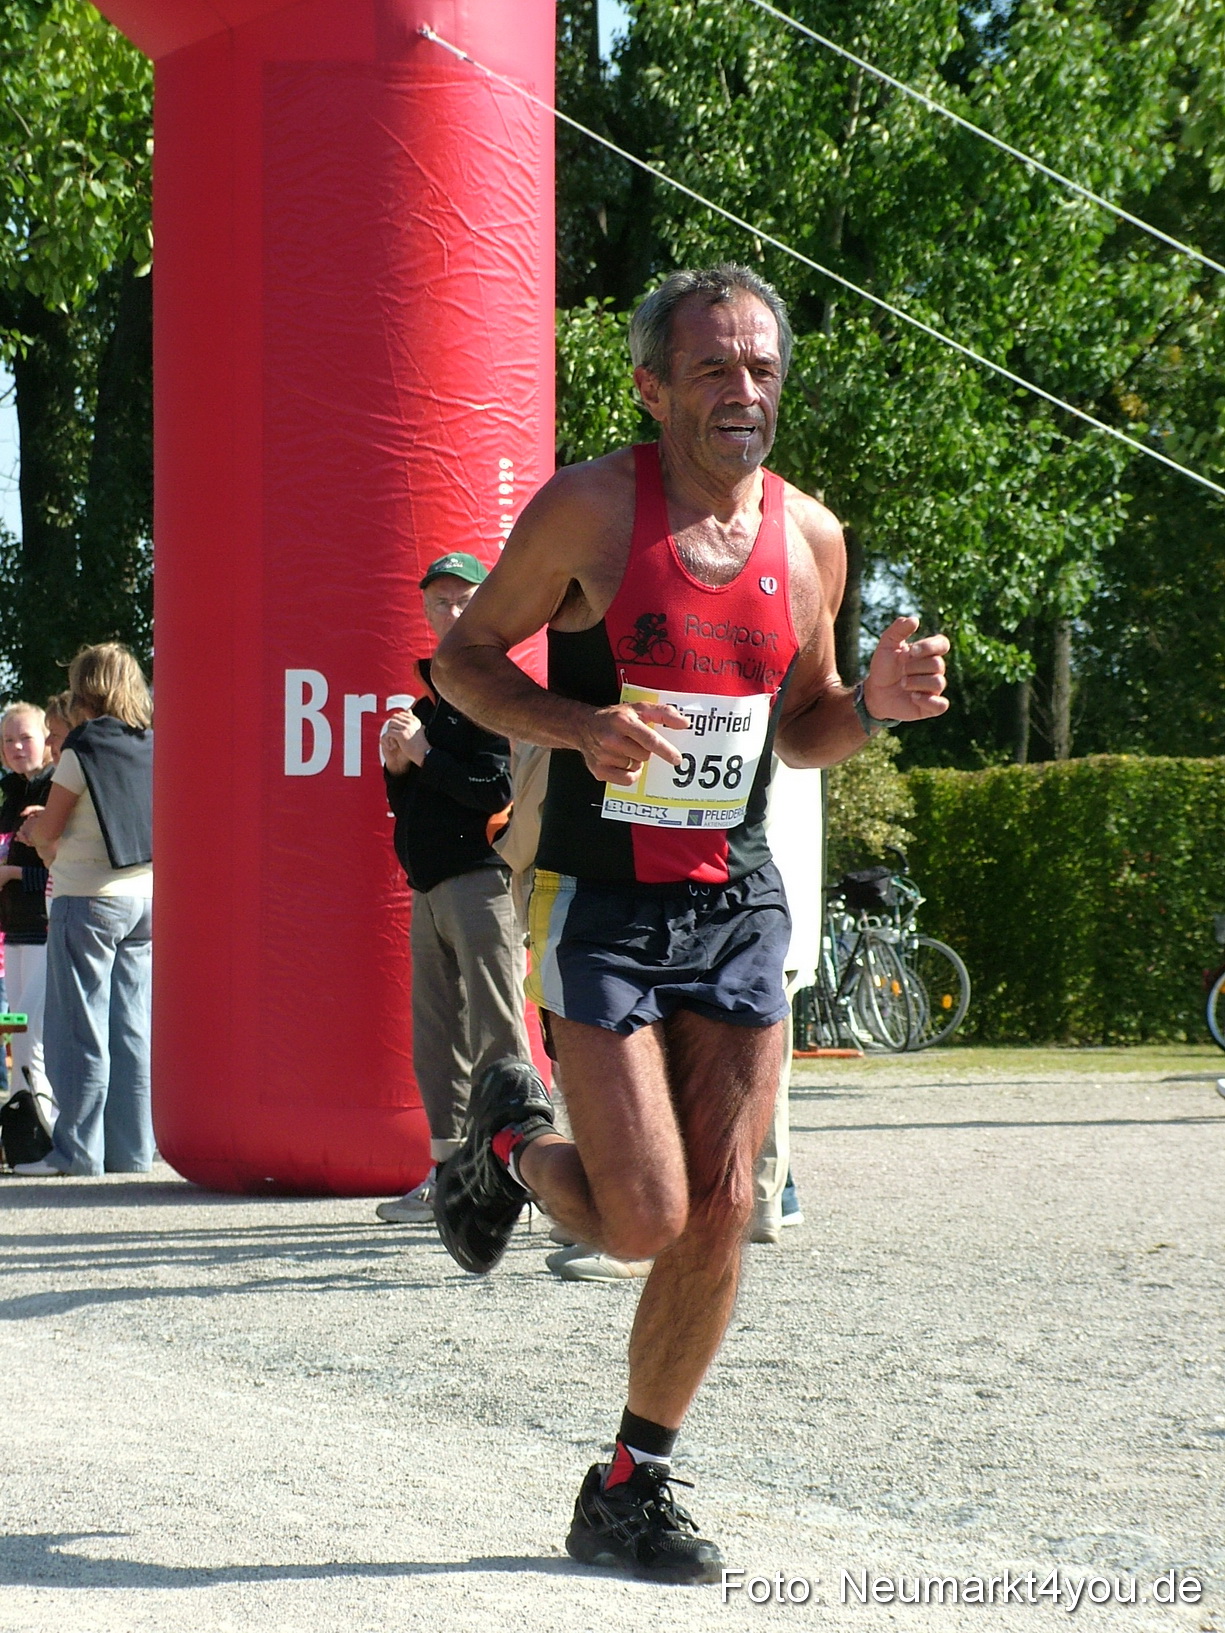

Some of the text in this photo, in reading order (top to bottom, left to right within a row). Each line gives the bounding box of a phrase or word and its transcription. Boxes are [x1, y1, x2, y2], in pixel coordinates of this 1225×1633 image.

[498, 457, 514, 506] 1929
[684, 613, 779, 652] Radsport
[681, 649, 783, 686] Neumüller
[672, 752, 743, 789] 958
[605, 799, 669, 819] BOCK
